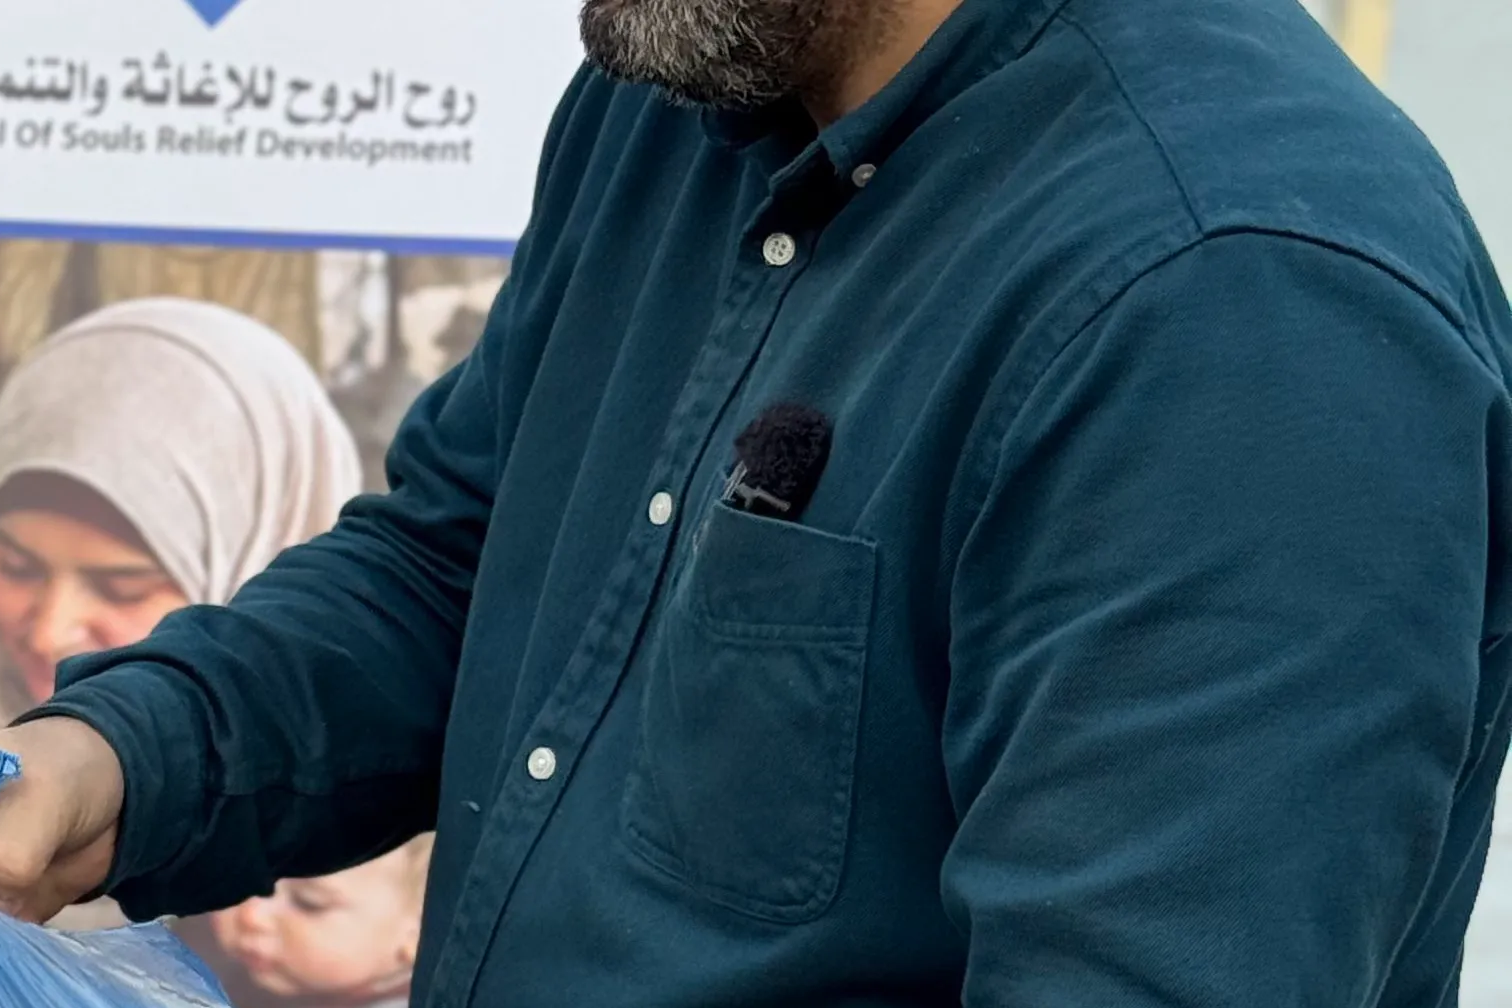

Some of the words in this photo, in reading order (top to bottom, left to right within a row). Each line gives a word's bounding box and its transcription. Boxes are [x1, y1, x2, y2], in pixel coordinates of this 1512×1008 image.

[121, 50, 276, 125] للإغاثة
[284, 68, 394, 125] الروح
[403, 81, 476, 129] روح
[15, 119, 54, 149] Of
[61, 121, 146, 151] Souls
[156, 125, 246, 156] Relief
[256, 128, 473, 168] Development
